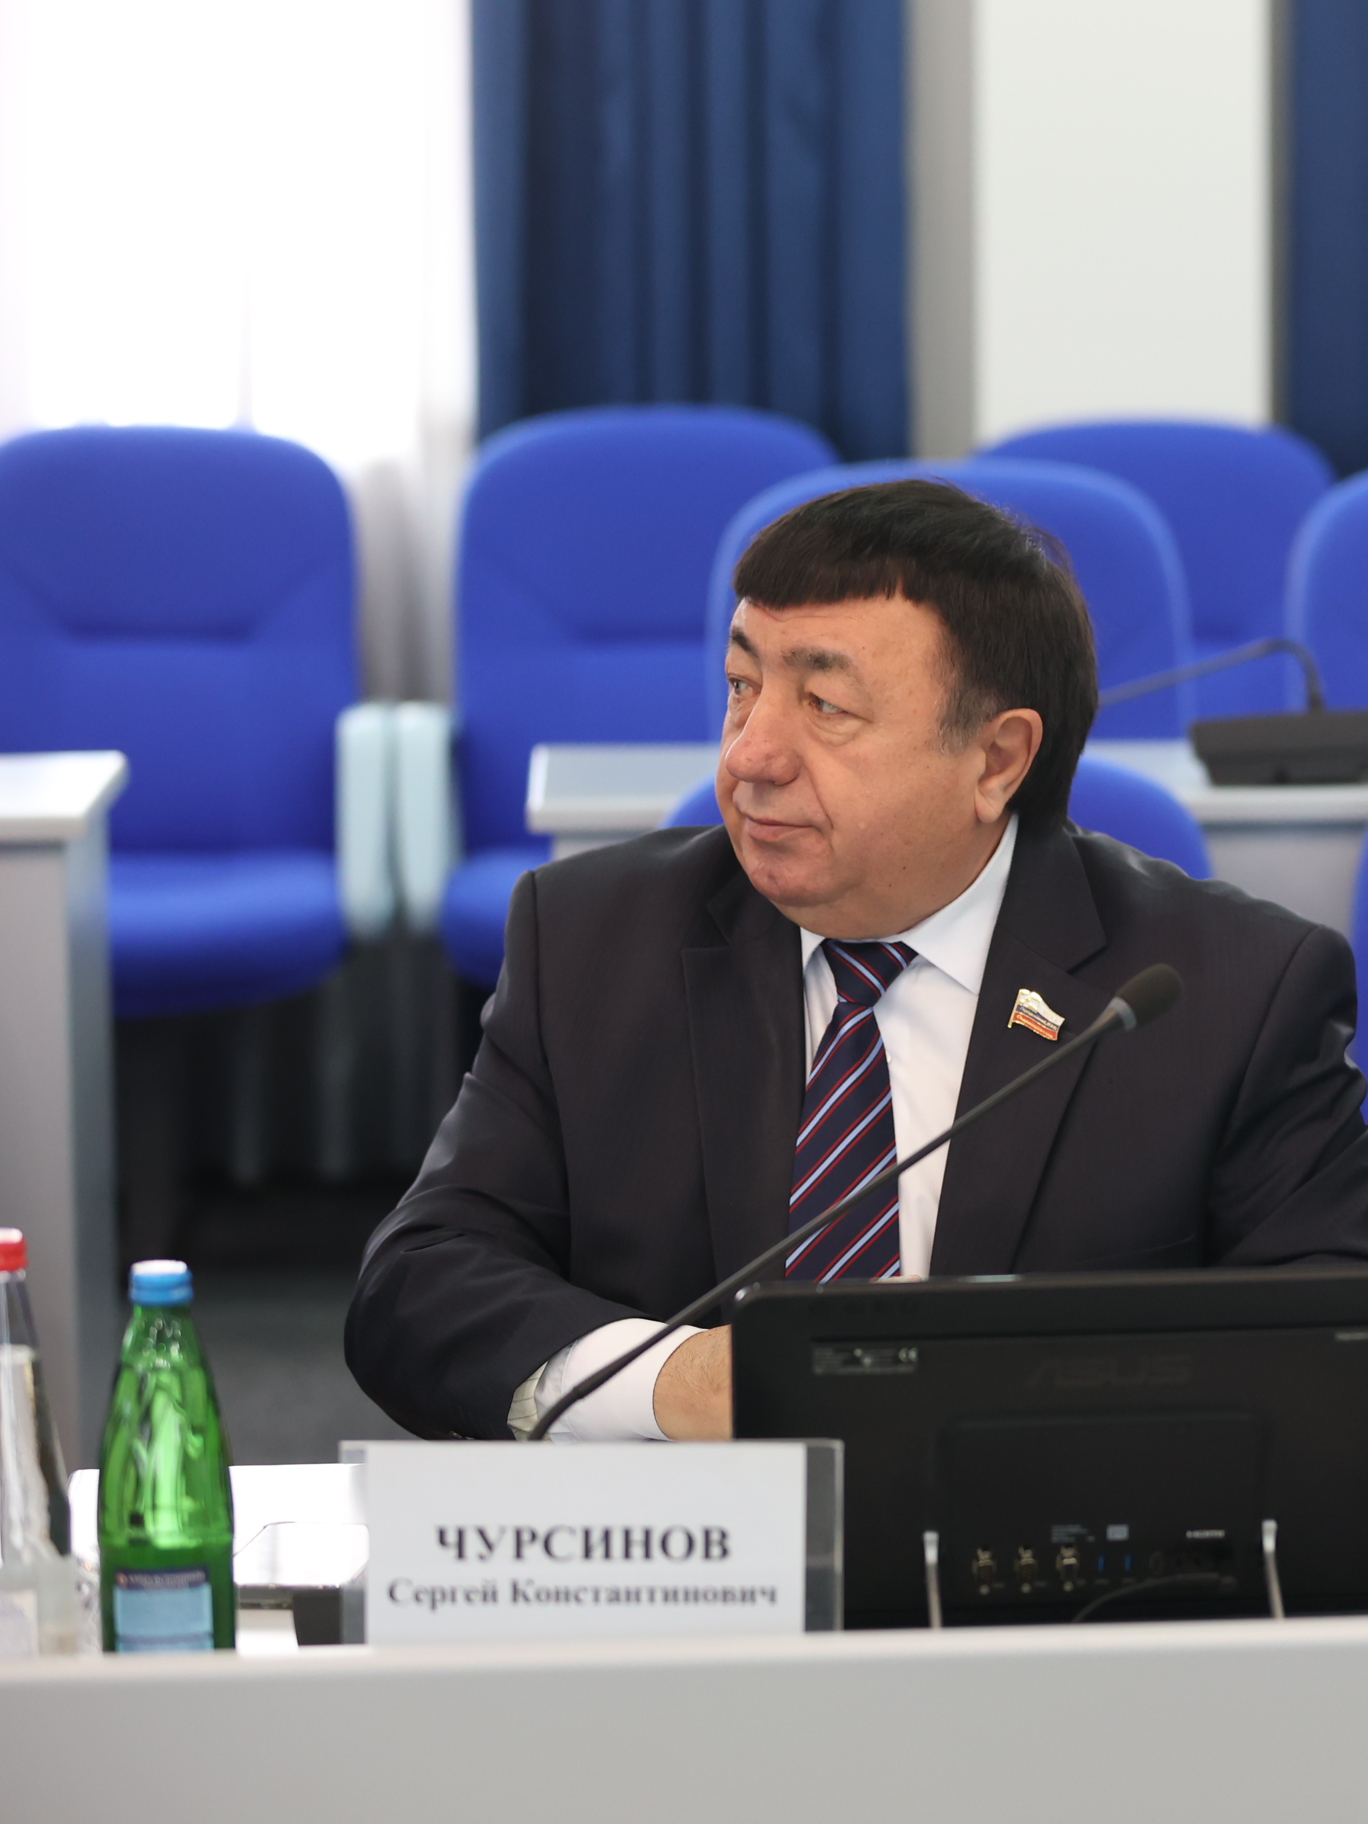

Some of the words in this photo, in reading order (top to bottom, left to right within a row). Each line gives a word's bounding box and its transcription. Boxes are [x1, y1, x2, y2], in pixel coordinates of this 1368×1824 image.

[436, 1526, 731, 1562] ЧУРСИНОВ
[387, 1580, 498, 1613] Сергей
[510, 1579, 777, 1605] Константинович
